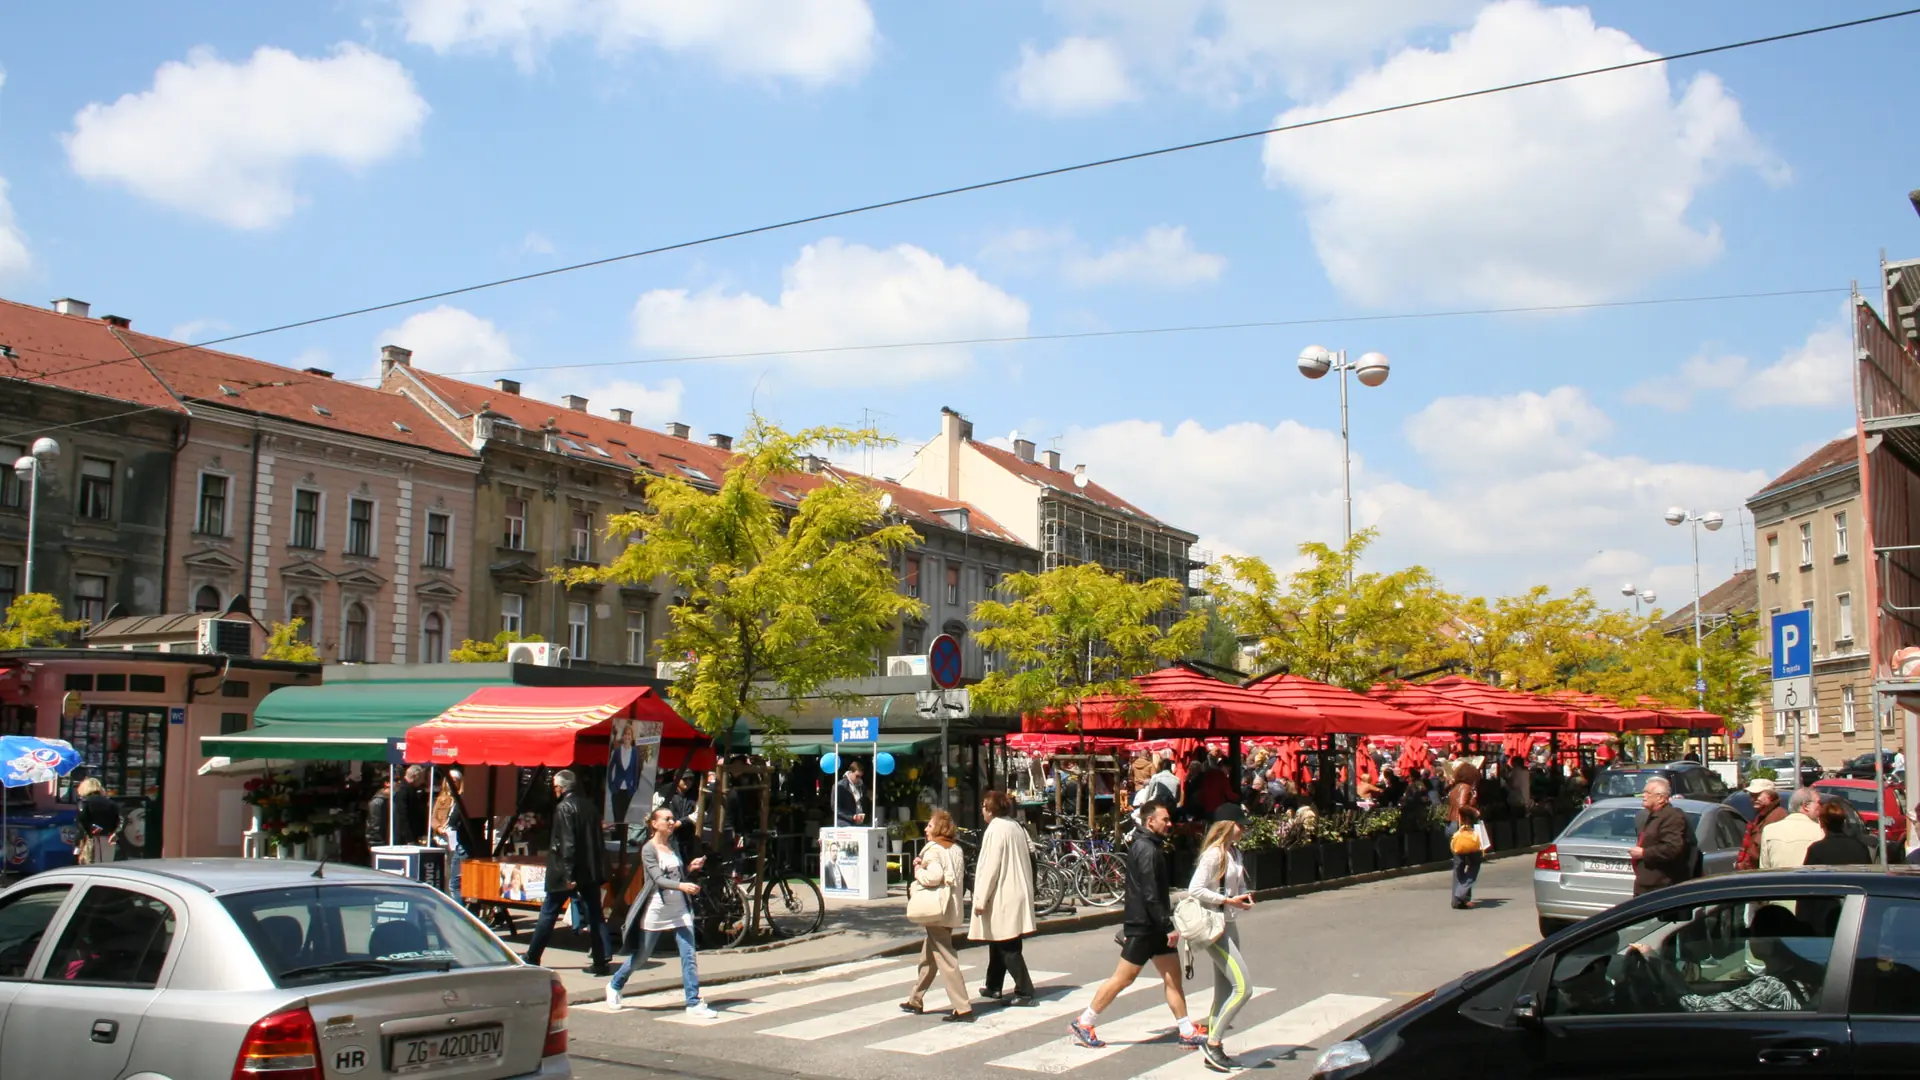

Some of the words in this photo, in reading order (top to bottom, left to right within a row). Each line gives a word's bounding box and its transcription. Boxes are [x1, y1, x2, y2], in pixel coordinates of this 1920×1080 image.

[1782, 624, 1799, 665] P
[172, 712, 184, 721] WC
[842, 717, 869, 730] Zagreb
[841, 729, 849, 742] je
[389, 951, 424, 960] OPEL
[407, 1041, 428, 1064] ZG
[439, 1032, 500, 1058] 4200-DV
[336, 1050, 365, 1070] HR
